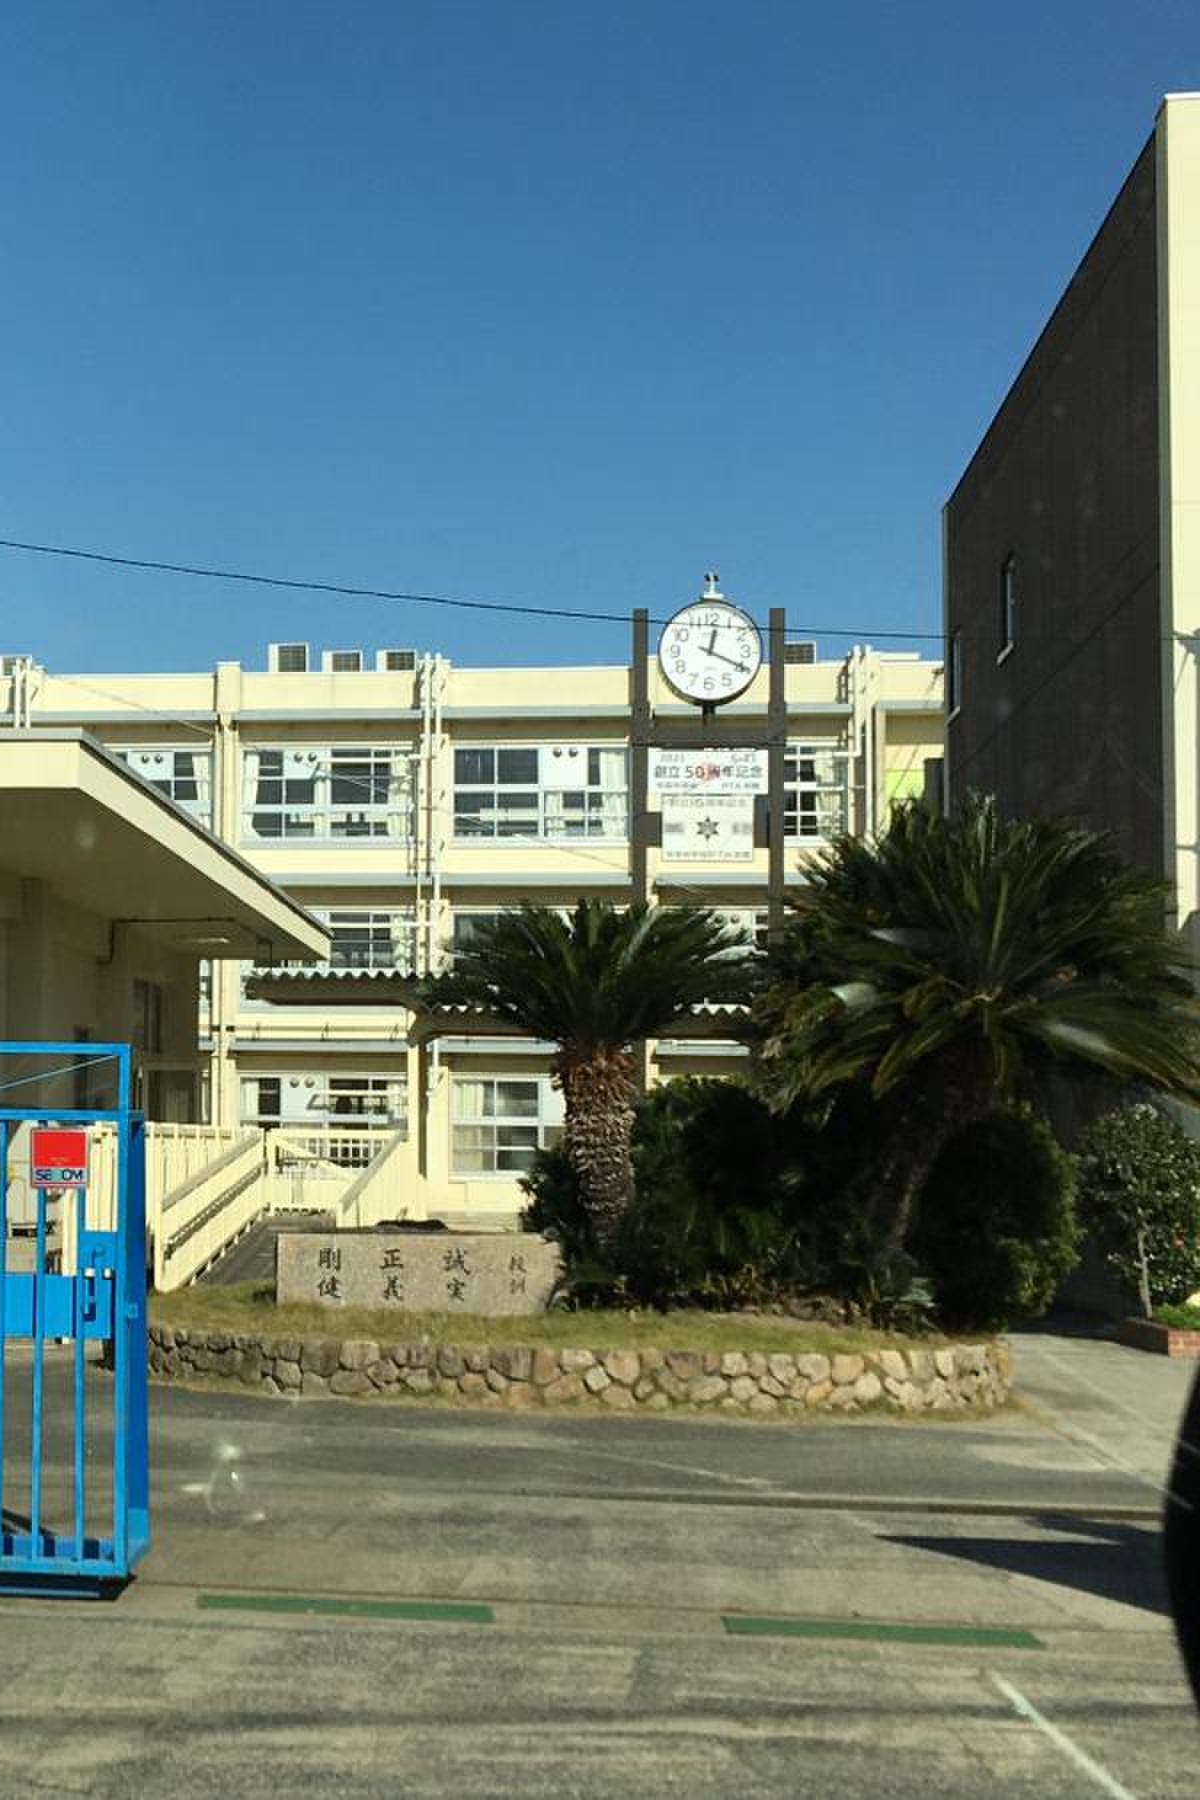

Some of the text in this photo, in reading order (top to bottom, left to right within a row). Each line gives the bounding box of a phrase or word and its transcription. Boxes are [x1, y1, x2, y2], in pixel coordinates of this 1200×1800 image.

[705, 613, 720, 625] 12
[670, 644, 681, 658] 9
[740, 644, 751, 658] 3
[675, 660, 686, 673] 8
[688, 672, 699, 687] 7
[703, 677, 715, 690] 6
[721, 673, 732, 687] 5
[317, 1247, 341, 1298] 剛健
